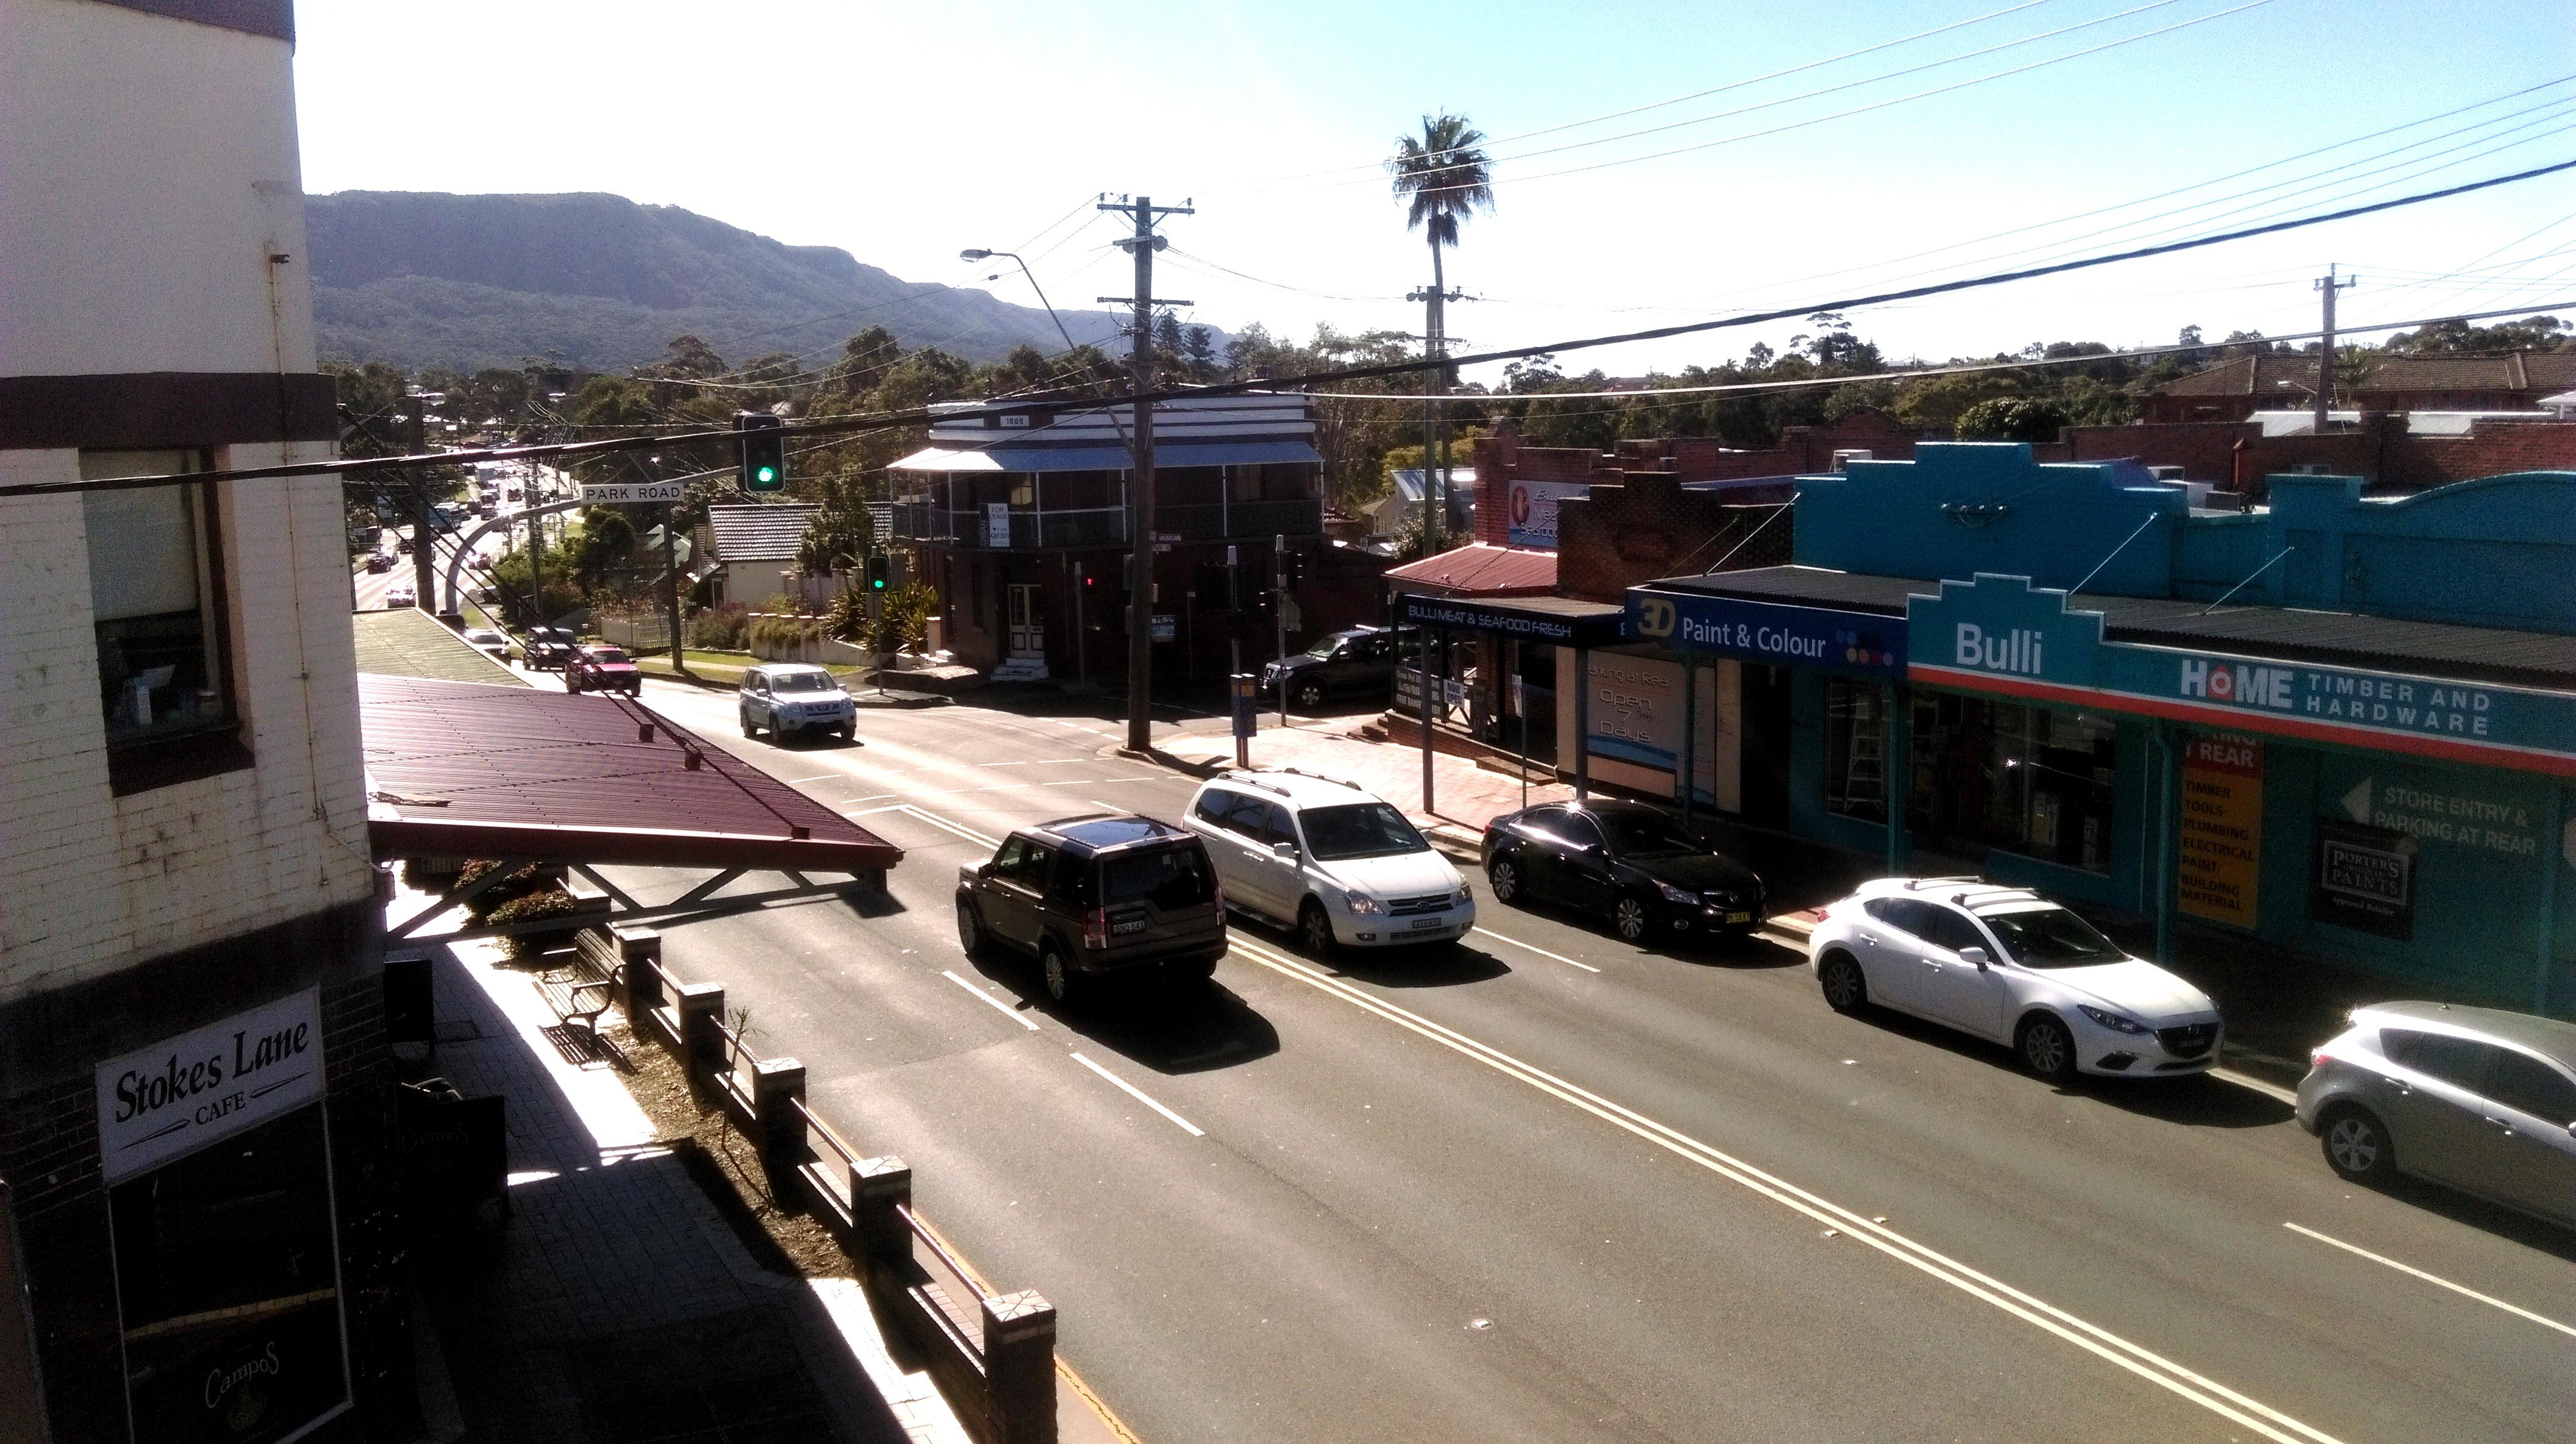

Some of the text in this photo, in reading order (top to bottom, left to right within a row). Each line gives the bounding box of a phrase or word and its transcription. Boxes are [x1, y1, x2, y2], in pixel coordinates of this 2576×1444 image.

[586, 487, 680, 500] PARK ROAD
[1534, 489, 1567, 502] Bull
[1534, 507, 1557, 521] Mea
[1521, 523, 1557, 538] Seafoo
[1409, 606, 1572, 638] BULLI MEAT & SEAFOOD FRESH
[1637, 598, 1676, 637] 3D
[1683, 617, 1826, 658] Paint & Colour
[1956, 623, 2042, 674] Bulli
[1447, 682, 1461, 694] NOW
[1587, 666, 1672, 687] arking at Rear
[2180, 659, 2490, 712] HOME TIMBER AND
[1600, 690, 1651, 710] Open
[1617, 709, 1632, 723] 7
[2306, 695, 2488, 736] HARDWARE
[1600, 721, 1651, 743] Days
[2200, 742, 2253, 767] REAR
[2185, 780, 2231, 798] TIMBER
[2185, 799, 2224, 817] TOOLS
[2385, 787, 2527, 827] STORE ENTRY &
[2184, 817, 2249, 841] PLUMBING
[2375, 811, 2536, 856] PARKING AT REAR
[2183, 837, 2255, 862] ELECTRICAL
[2182, 855, 2217, 873] PAINT
[2181, 873, 2240, 897] BUILDING
[2333, 869, 2397, 895] PAINTS
[2180, 887, 2242, 911] MATERIAL
[115, 1022, 309, 1123] Stokes Lane
[195, 1092, 245, 1126] CAFE
